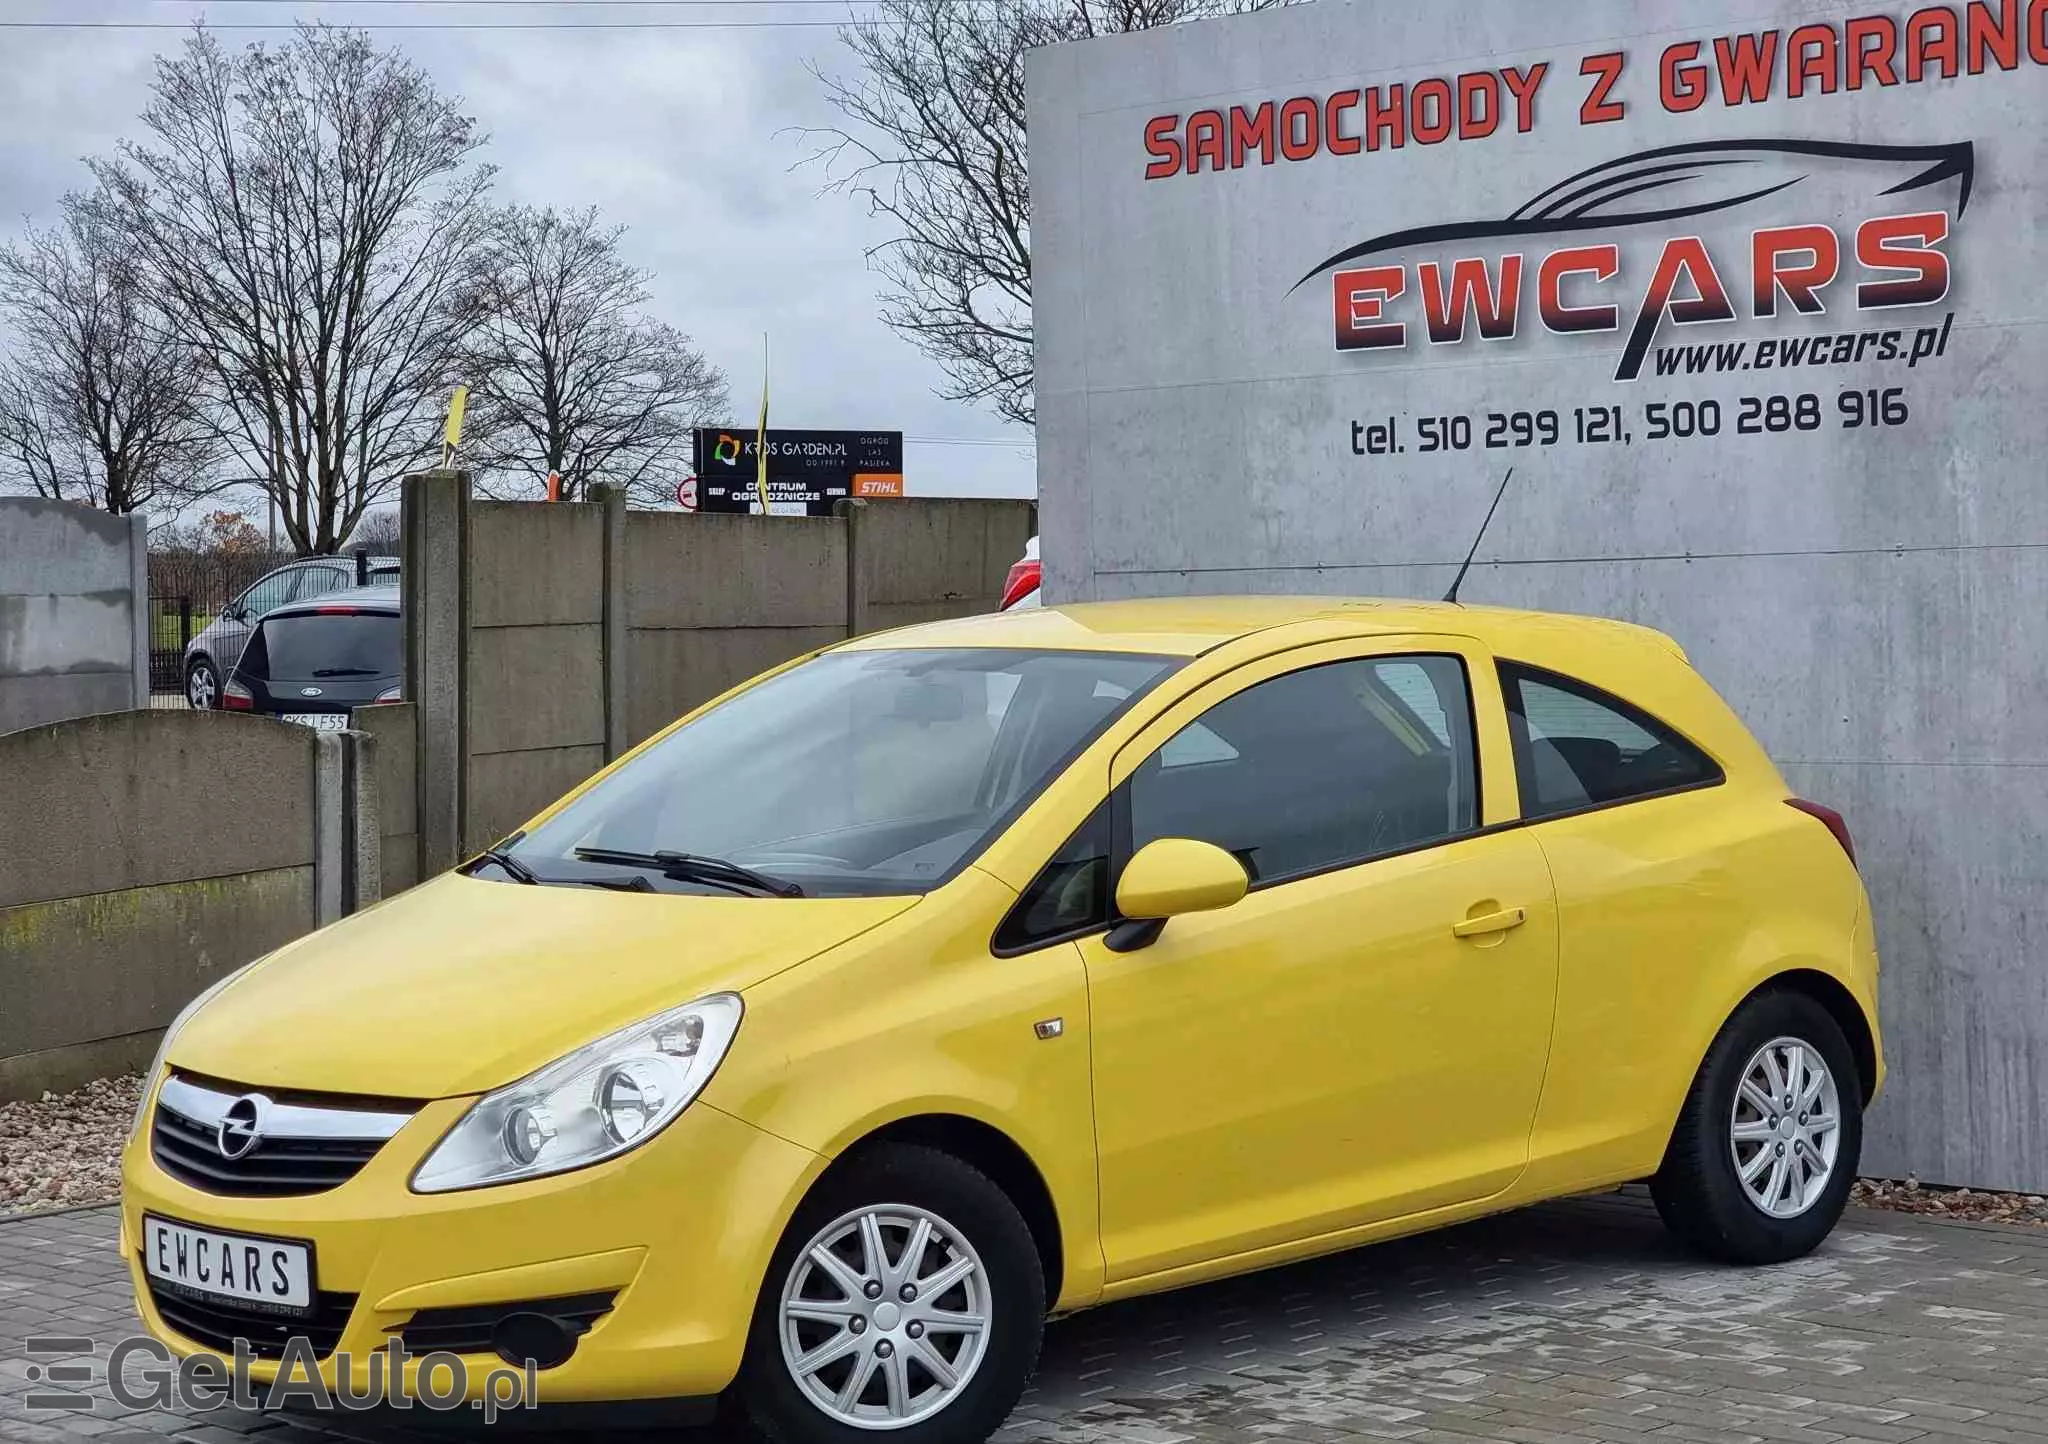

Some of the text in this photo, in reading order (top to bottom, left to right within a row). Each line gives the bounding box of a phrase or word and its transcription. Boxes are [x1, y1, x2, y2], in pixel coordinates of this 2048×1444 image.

[1144, 62, 1550, 181] SAMOCHODY
[1579, 51, 1626, 126] Z
[1332, 211, 1950, 382] EWCARS
[1655, 312, 1955, 378] www.ewcars.pl
[1351, 387, 1909, 456] tel. 510 299 121, 500 288 916
[861, 481, 899, 494] STIHL
[156, 1226, 290, 1297] EWCARS
